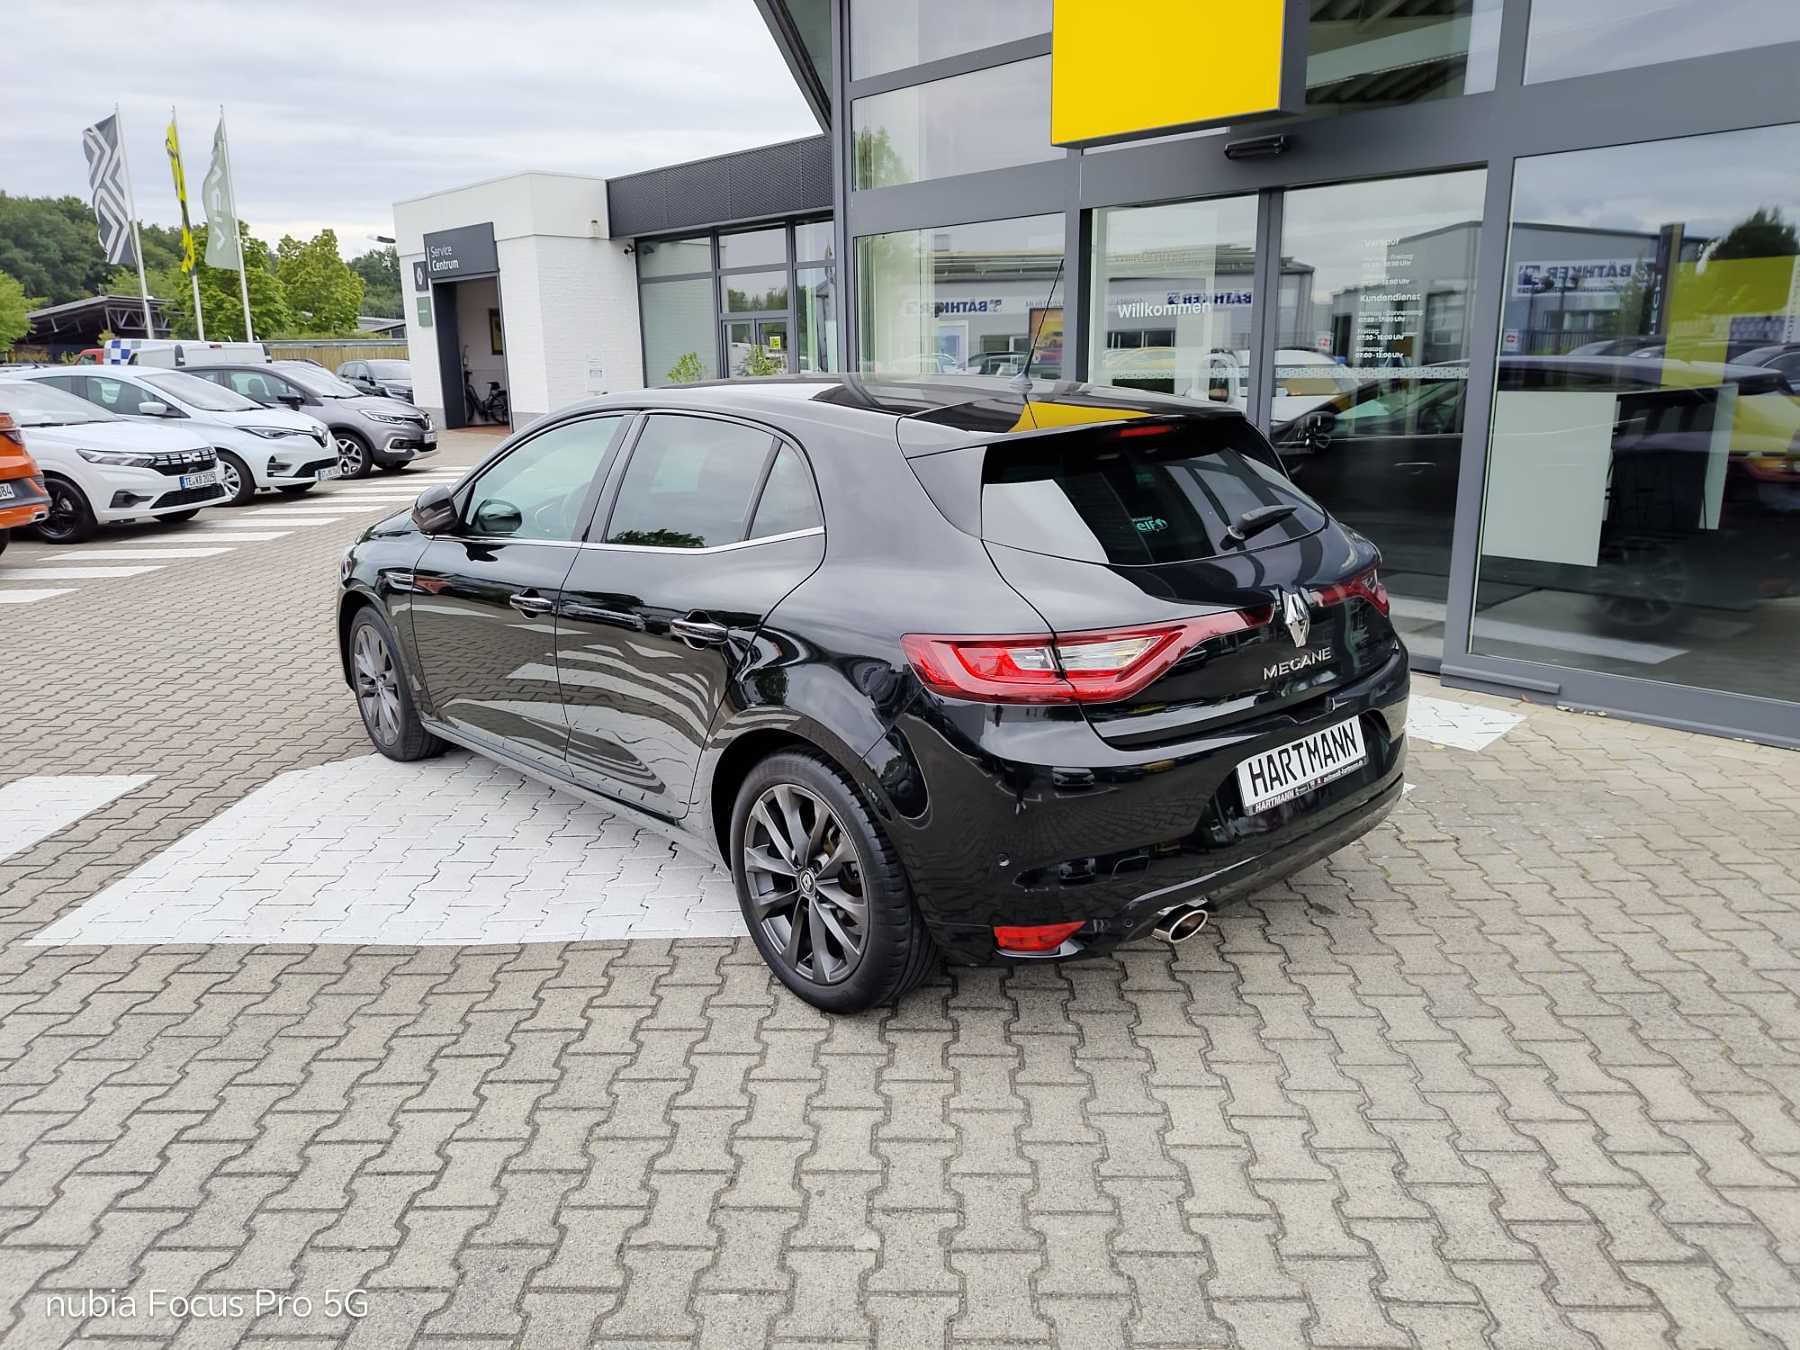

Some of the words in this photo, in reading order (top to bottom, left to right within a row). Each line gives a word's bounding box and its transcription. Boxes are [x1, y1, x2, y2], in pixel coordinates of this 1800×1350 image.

[430, 245, 452, 258] Service
[432, 259, 459, 271] Centrum
[1359, 293, 1421, 302] Kundendienst
[1117, 301, 1211, 318] Willkommen
[1263, 646, 1332, 680] MEGANE
[1248, 721, 1358, 797] HARTMANN
[1255, 789, 1295, 813] HARTMANN
